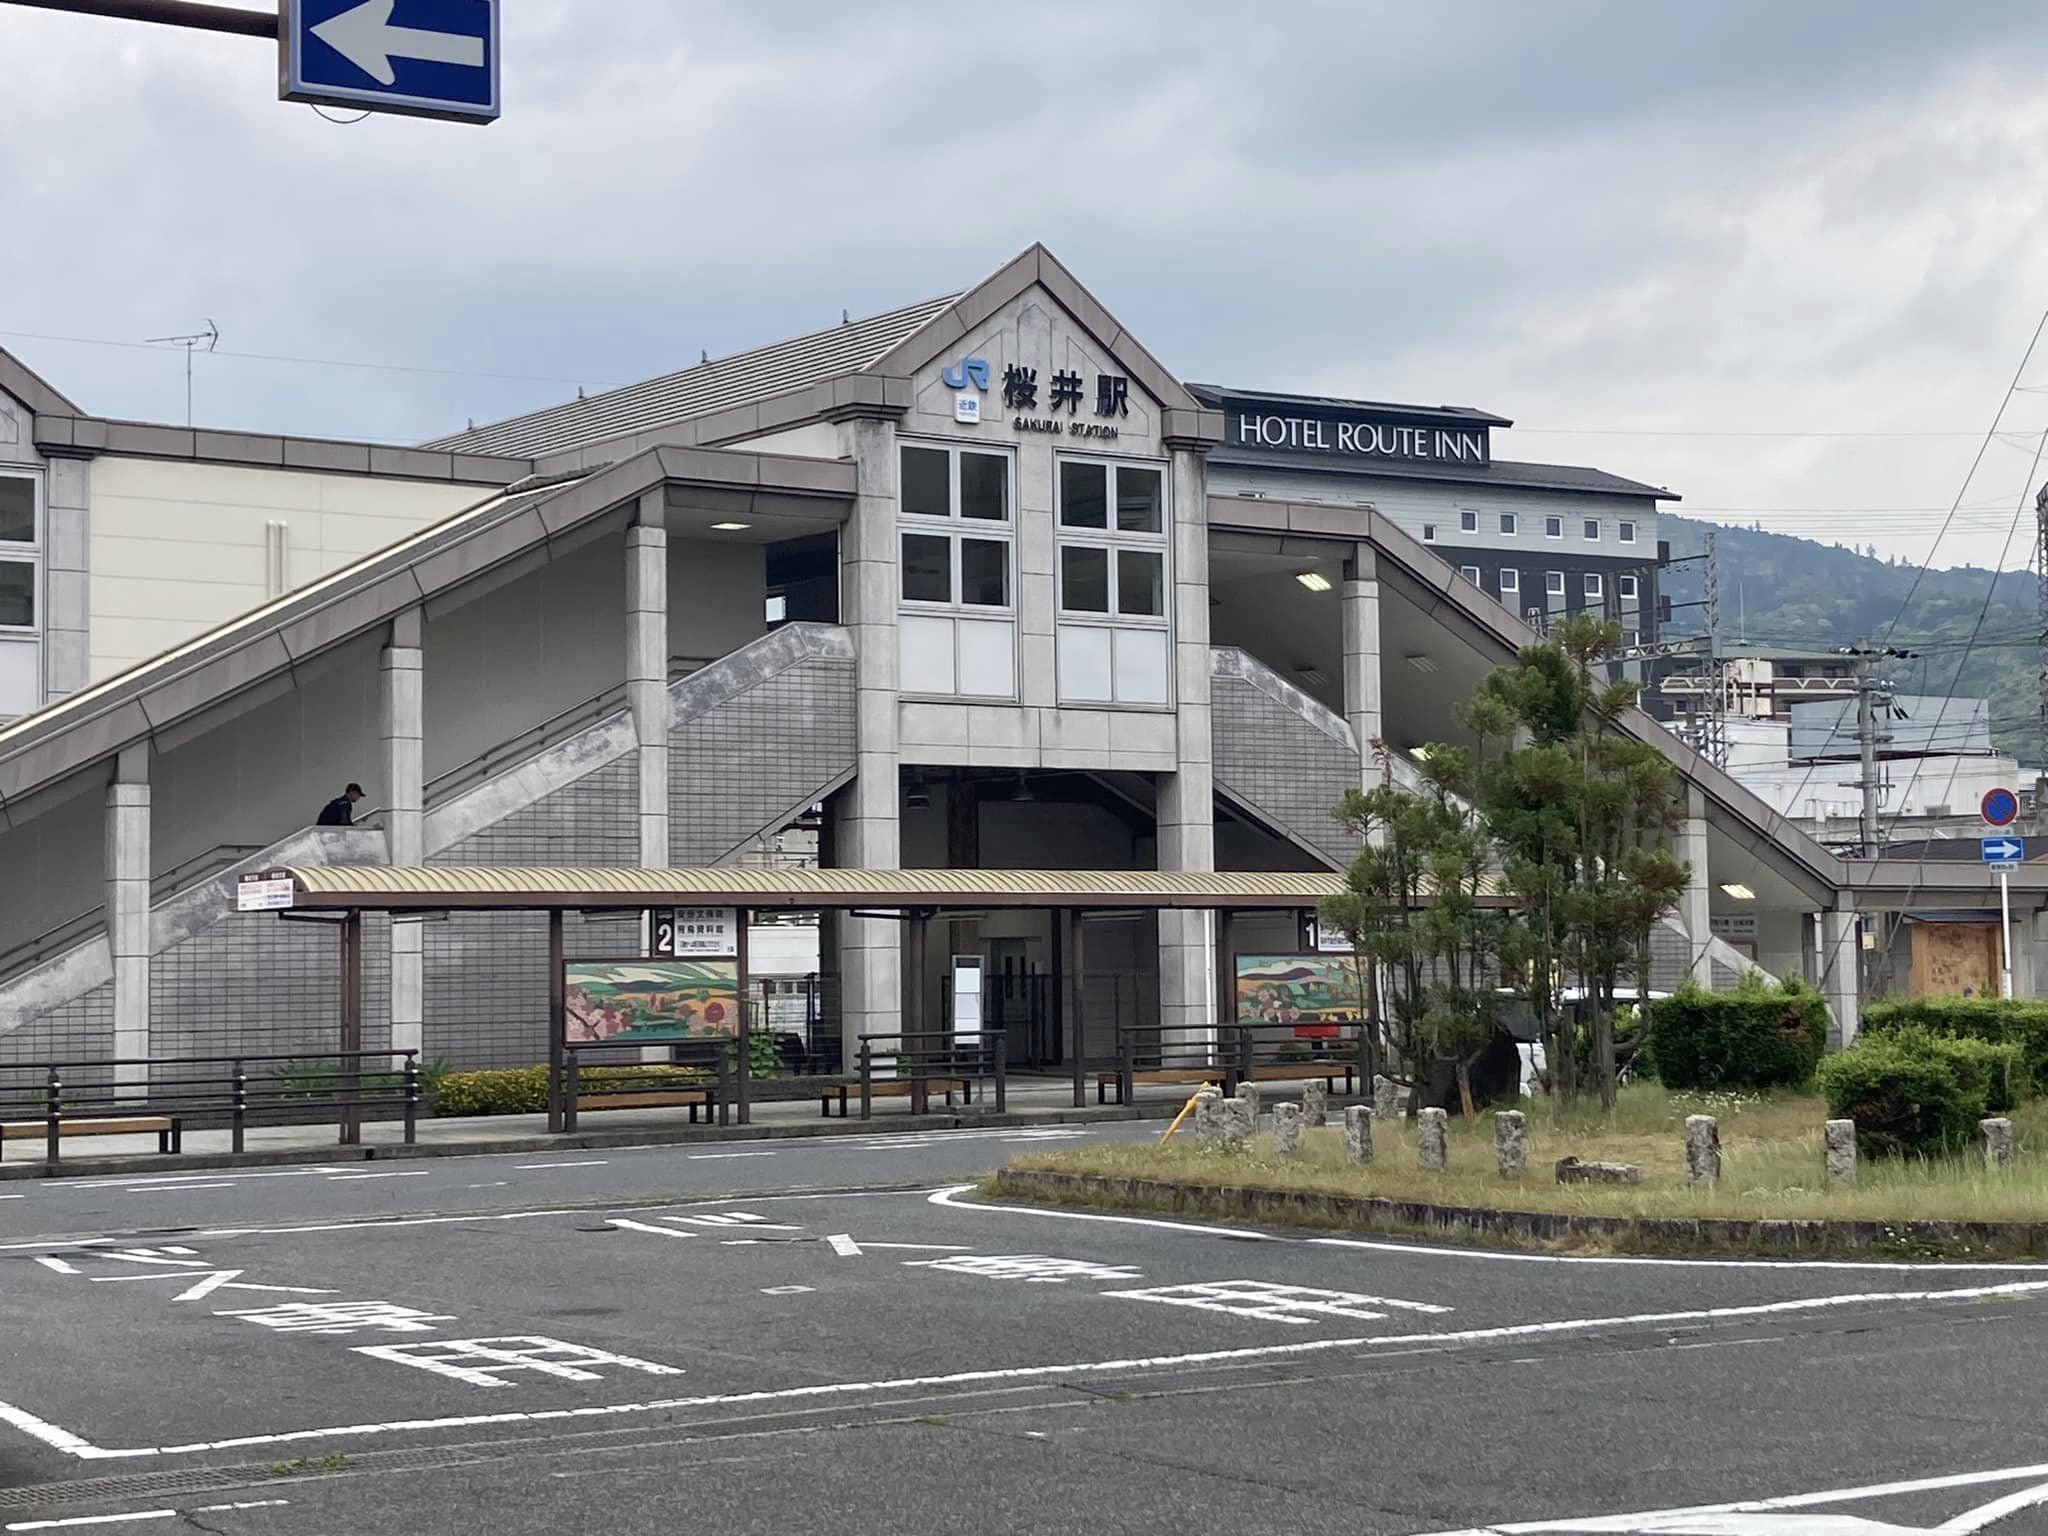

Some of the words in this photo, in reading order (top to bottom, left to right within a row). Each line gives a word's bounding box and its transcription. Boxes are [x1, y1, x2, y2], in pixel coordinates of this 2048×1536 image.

[942, 358, 989, 392] JR
[1001, 363, 1129, 418] 桜井駅
[1013, 416, 1063, 435] SAKURAI
[1068, 422, 1119, 440] STATION
[1240, 414, 1330, 449] HOTEL
[1338, 422, 1427, 457] ROUTE
[1435, 430, 1482, 461] INN
[657, 923, 673, 952] 2
[1304, 922, 1315, 948] 1
